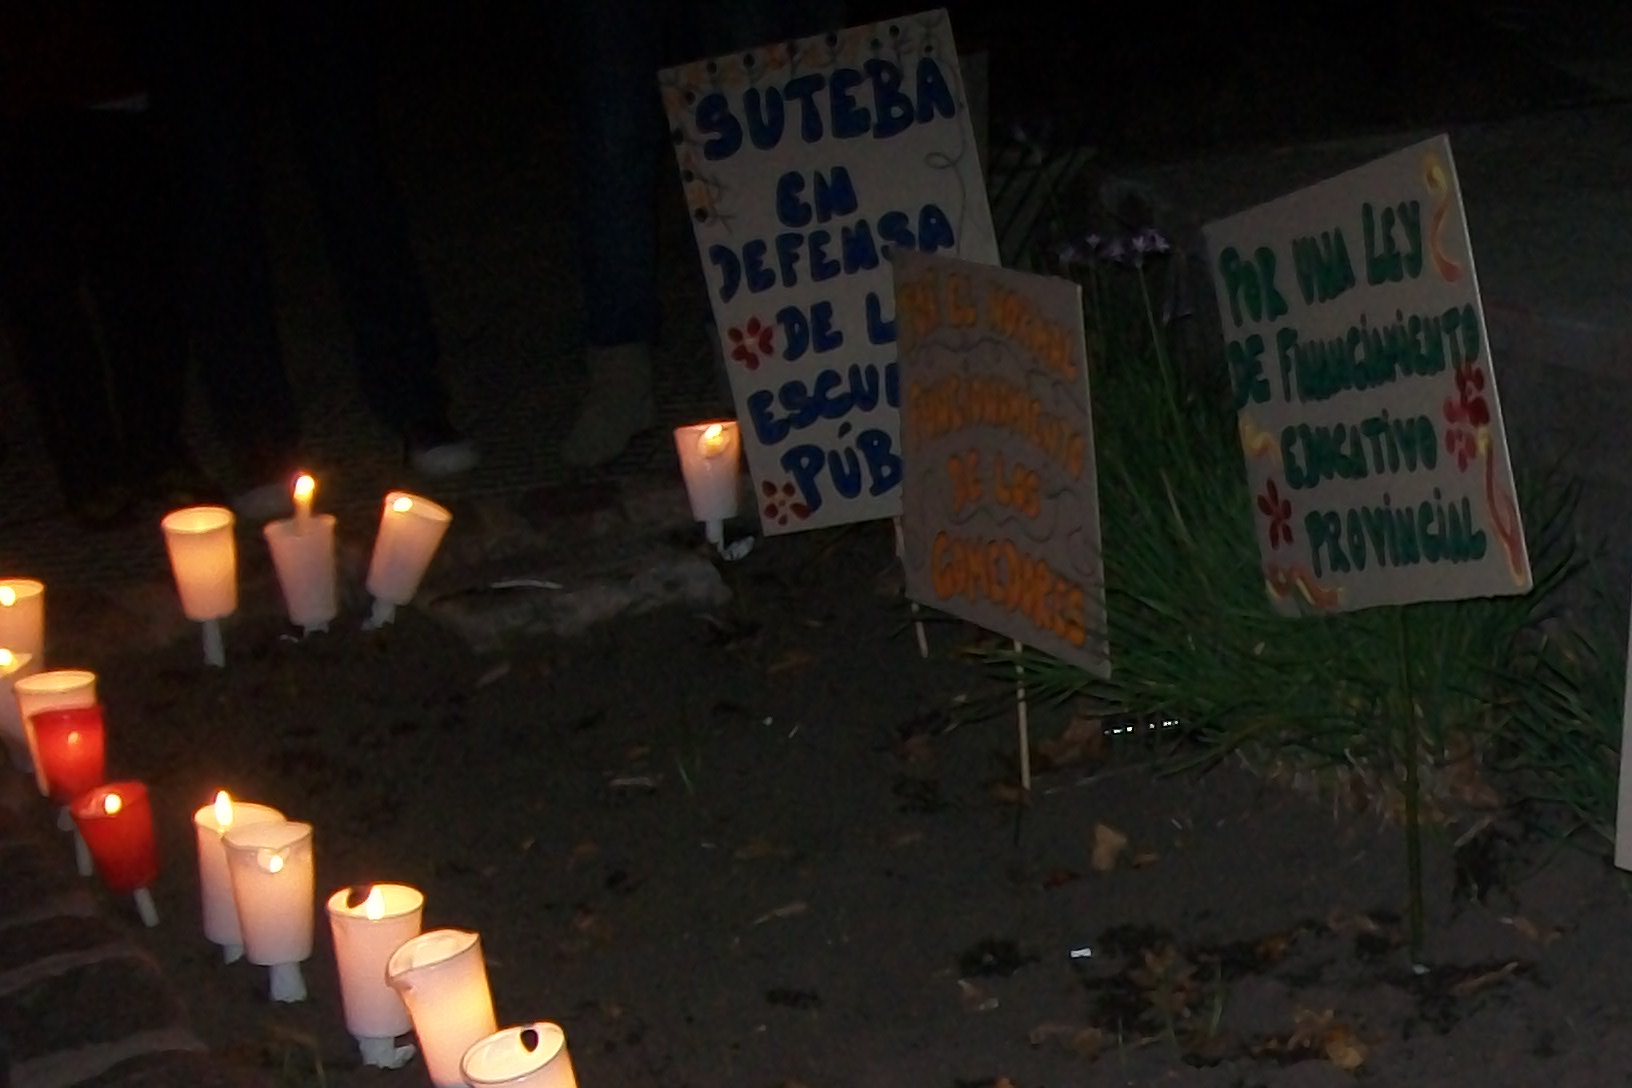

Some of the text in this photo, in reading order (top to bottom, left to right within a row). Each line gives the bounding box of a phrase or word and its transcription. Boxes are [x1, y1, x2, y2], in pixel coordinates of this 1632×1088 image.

[696, 57, 955, 160] SUTEBA
[708, 205, 954, 303] DEFENSA
[1218, 246, 1289, 327] POR
[1362, 200, 1423, 286] LEY
[776, 292, 897, 361] DE L
[1227, 334, 1271, 409] DE
[747, 362, 900, 445] ESCU
[781, 421, 902, 511] PÚB
